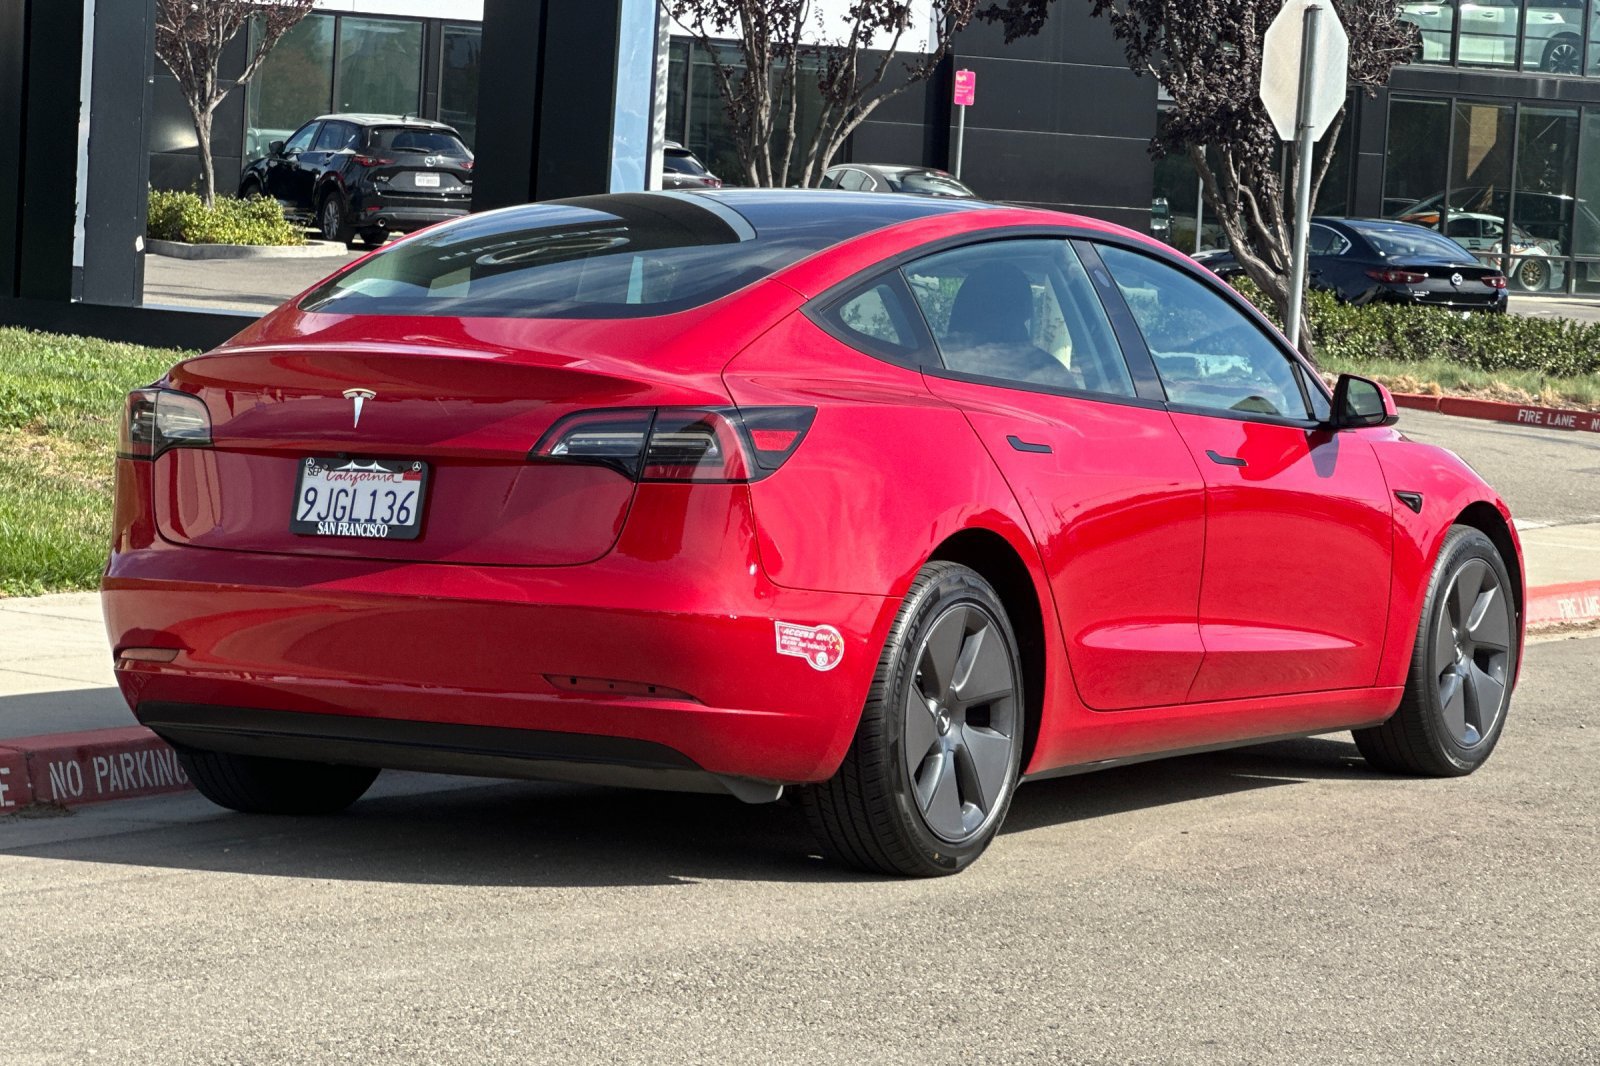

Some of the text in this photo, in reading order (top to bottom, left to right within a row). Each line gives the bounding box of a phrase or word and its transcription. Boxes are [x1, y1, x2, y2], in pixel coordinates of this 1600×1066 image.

[1517, 408, 1543, 424] FIRE
[1547, 413, 1577, 428] LANE
[1591, 418, 1600, 431] N
[326, 470, 402, 487] California
[300, 486, 415, 525] 9JGL136
[317, 521, 388, 538] SAN FRANCISCO
[49, 760, 84, 801] NO
